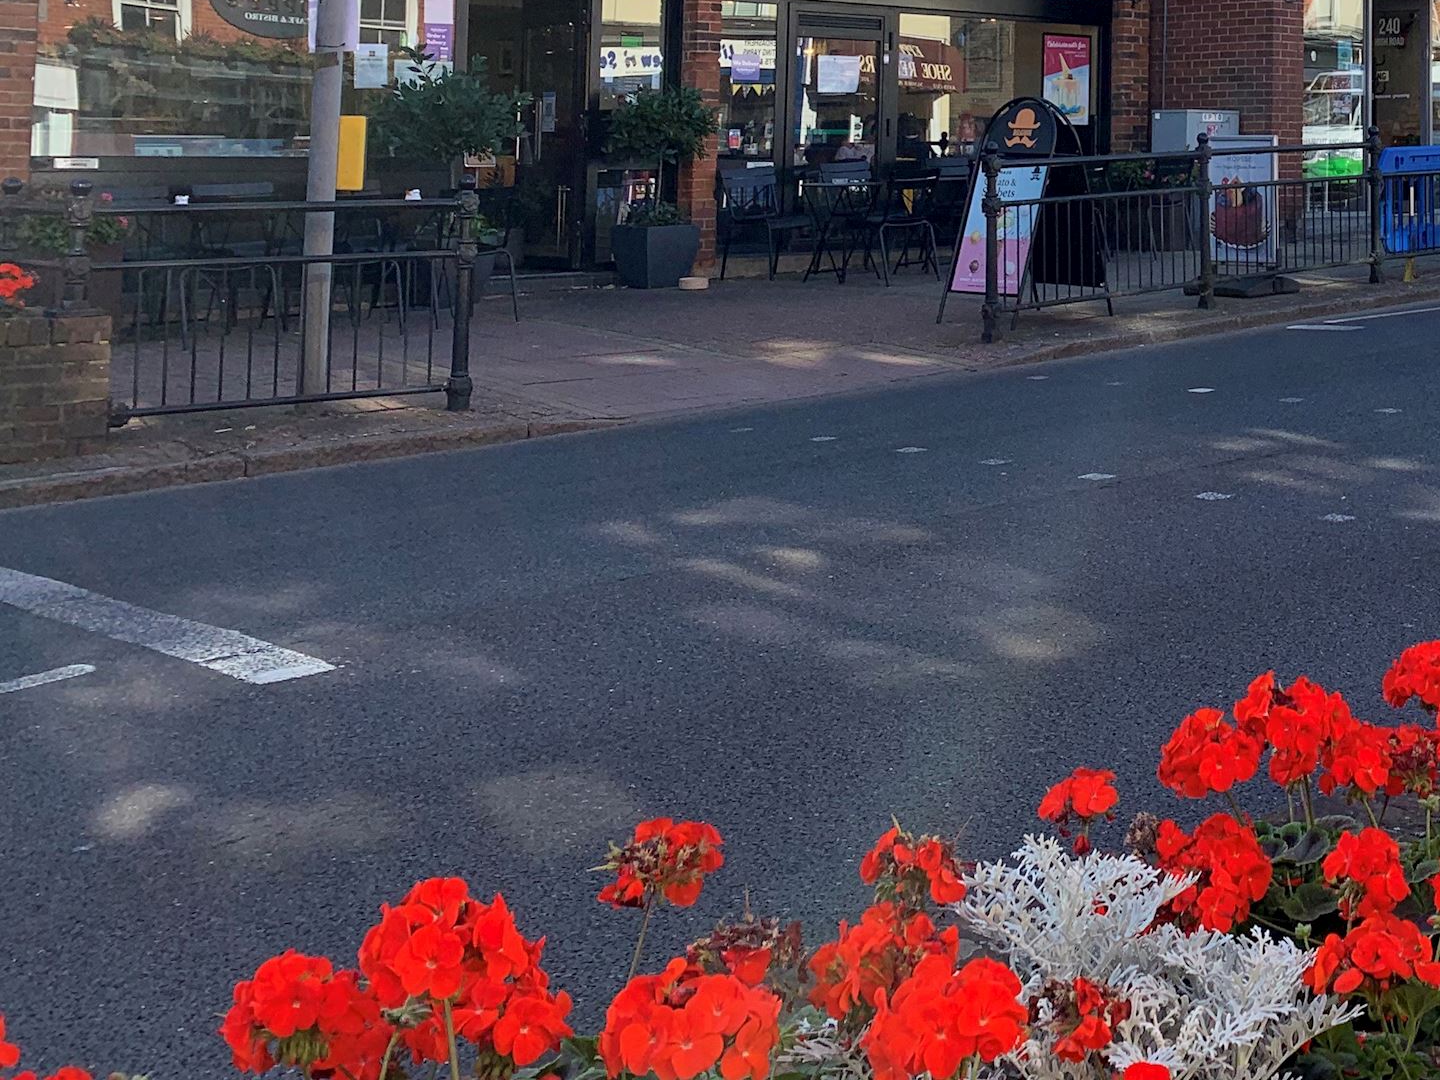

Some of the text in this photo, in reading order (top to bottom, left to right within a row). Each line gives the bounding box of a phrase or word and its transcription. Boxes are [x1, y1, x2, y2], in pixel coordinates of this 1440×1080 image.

[1379, 17, 1400, 35] 240
[1389, 37, 1405, 46] ROAD
[983, 187, 1015, 198] Sbets
